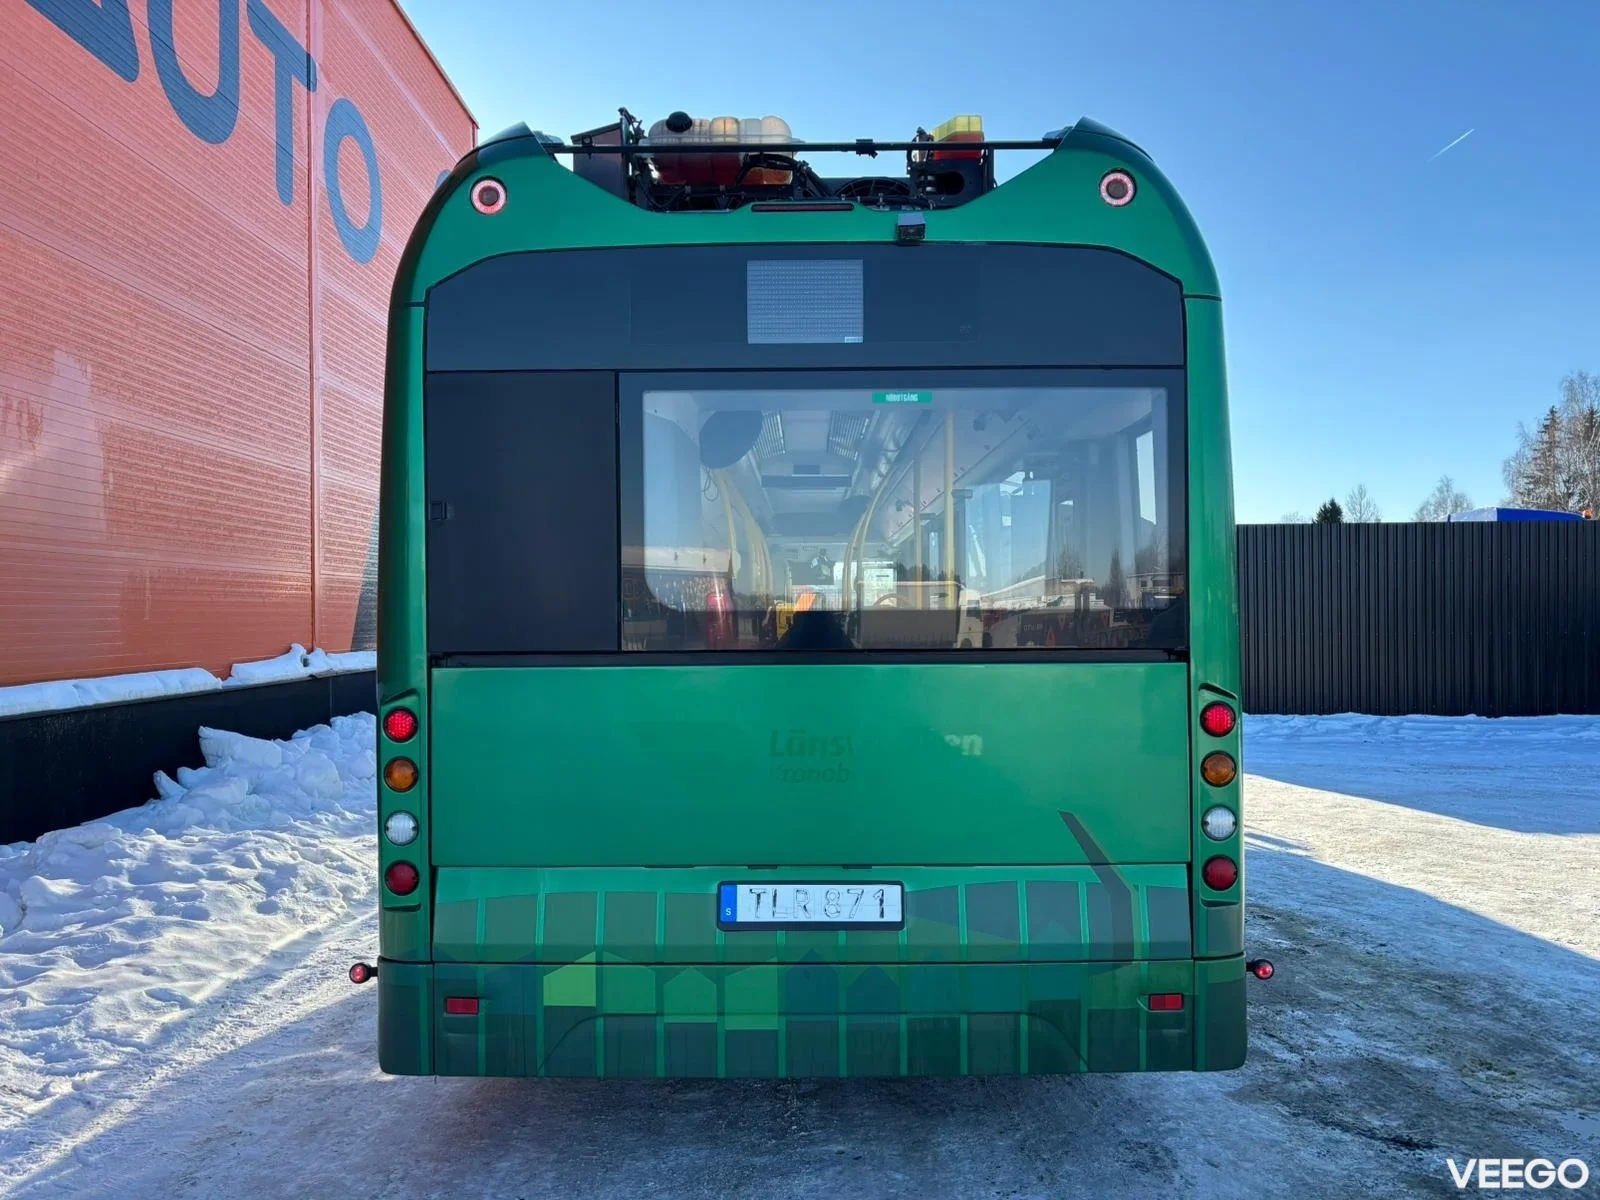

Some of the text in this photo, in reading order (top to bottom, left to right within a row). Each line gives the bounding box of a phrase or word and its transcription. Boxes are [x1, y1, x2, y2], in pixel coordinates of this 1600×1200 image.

[725, 907, 732, 916] S
[750, 888, 885, 919] TLR 871
